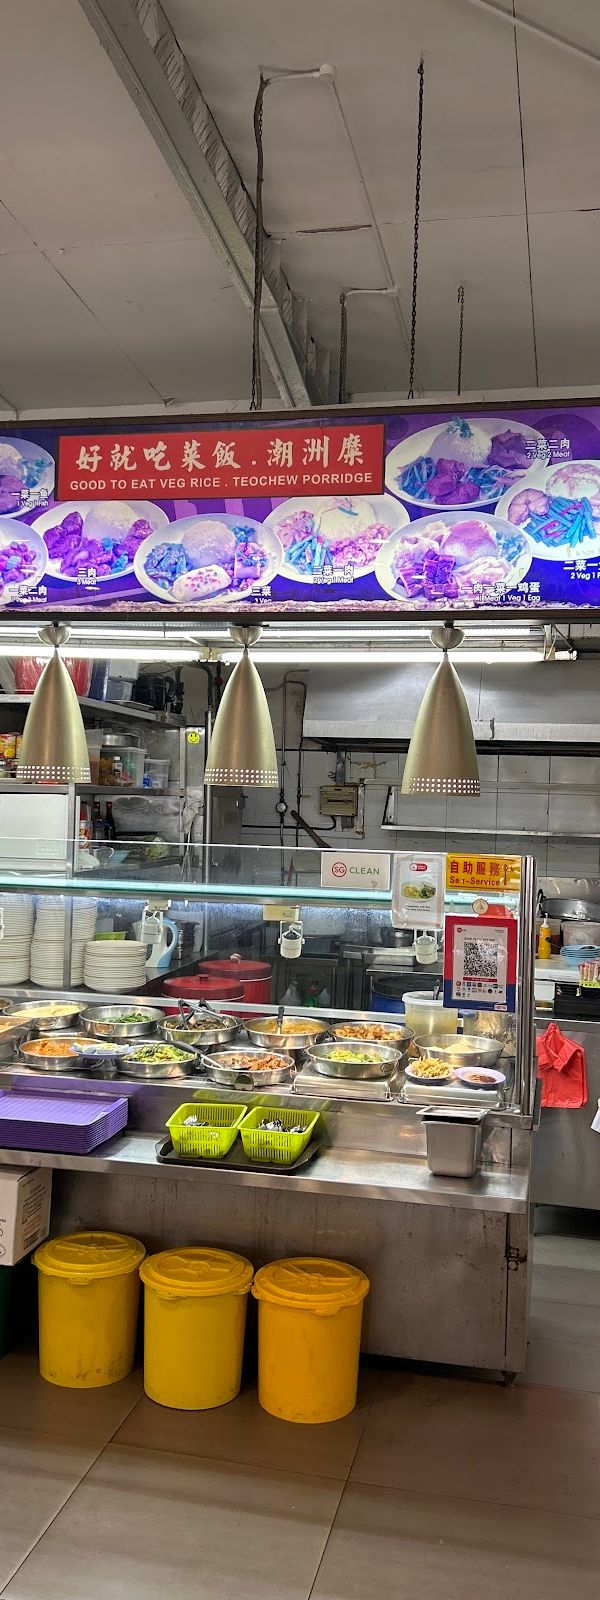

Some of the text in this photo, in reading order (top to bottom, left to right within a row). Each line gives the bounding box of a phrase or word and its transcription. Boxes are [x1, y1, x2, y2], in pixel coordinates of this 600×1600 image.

[525, 438, 570, 450] 二菜二肉
[532, 452, 546, 460] Veg
[70, 480, 106, 490] GOOD
[111, 479, 127, 489] TO
[131, 479, 156, 489] EAT
[160, 478, 186, 488] VEG
[190, 477, 220, 488] RICE
[233, 475, 299, 487] TEOCHEW
[302, 472, 373, 484] PORRIDGE
[312, 564, 355, 576] 二菜一肉
[563, 560, 600, 571] 二菜一
[77, 567, 97, 577] 三肉
[576, 572, 591, 580] Veg
[9, 585, 48, 596] 一菜二肉
[251, 585, 272, 596] 三菜
[349, 867, 380, 875] CLEAN
